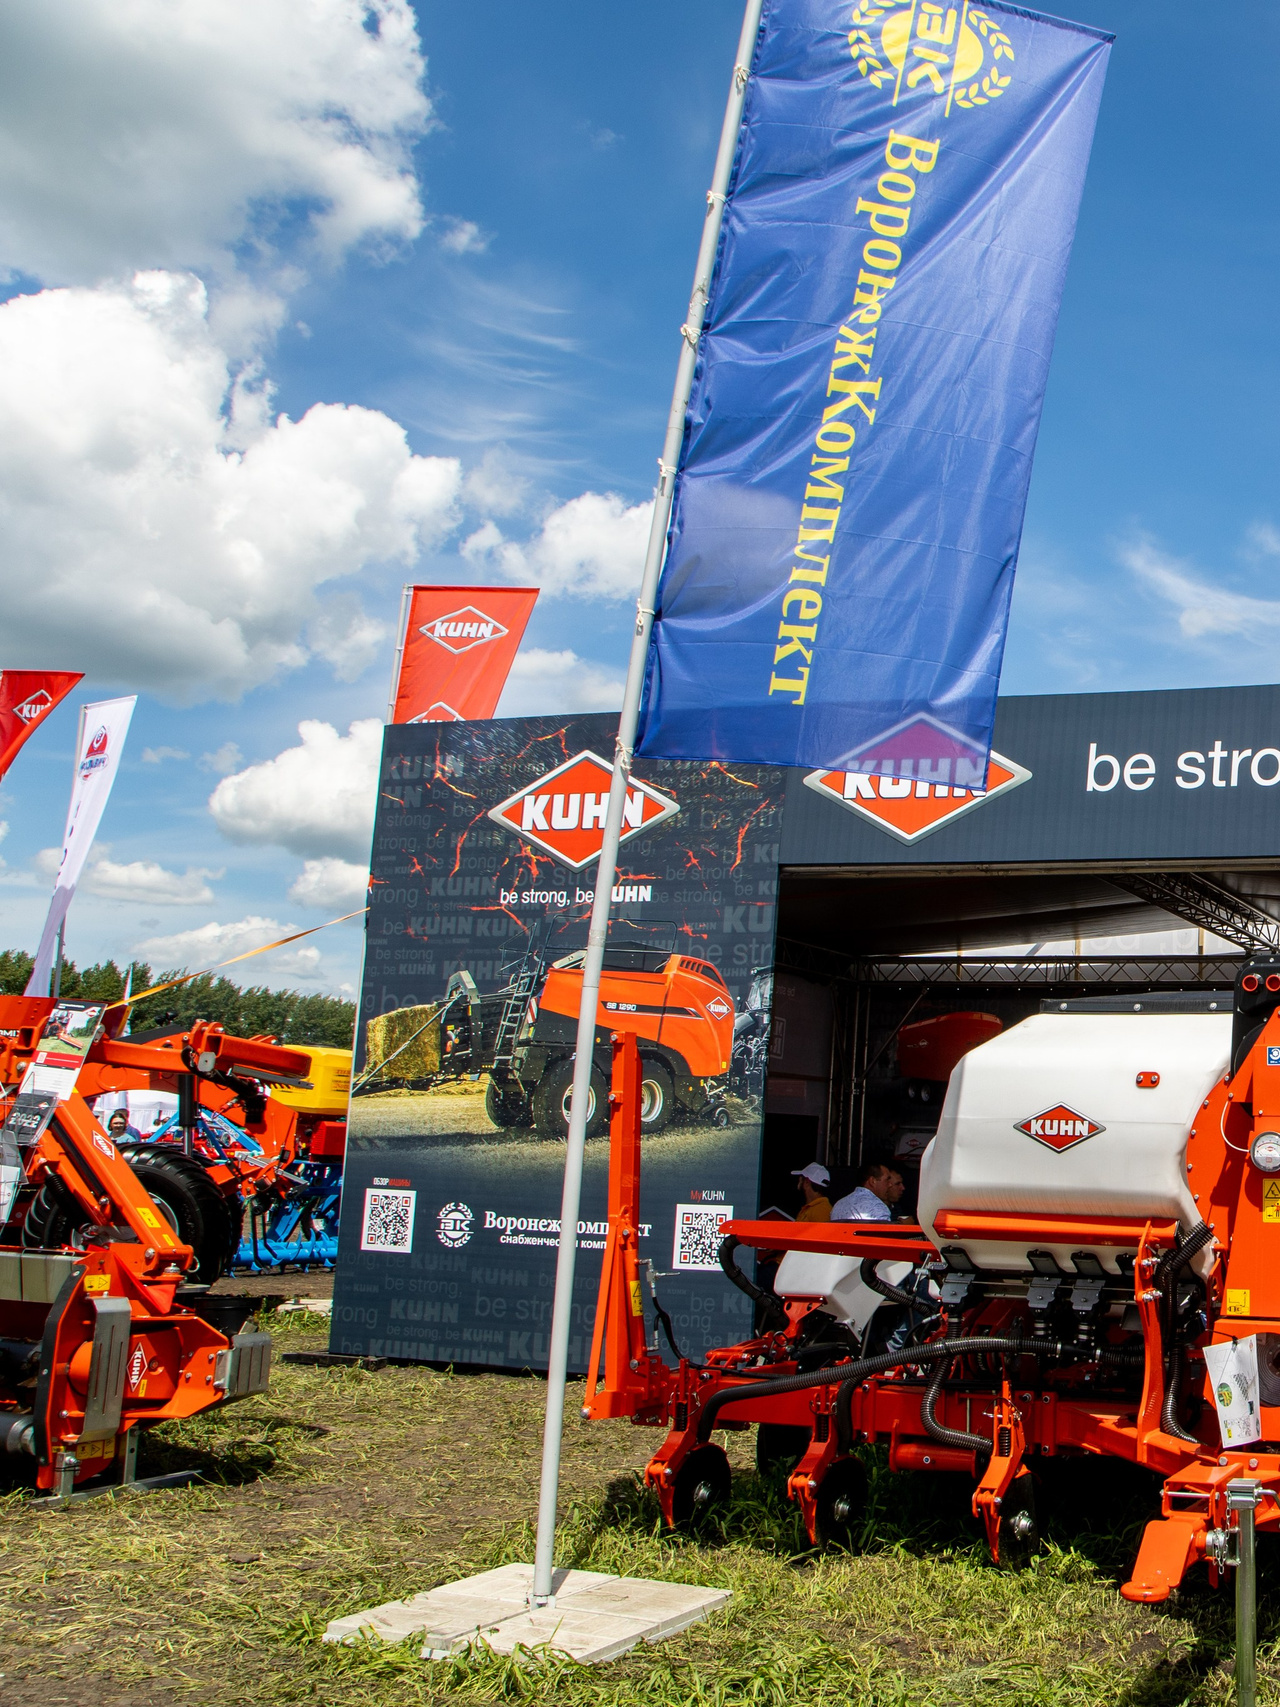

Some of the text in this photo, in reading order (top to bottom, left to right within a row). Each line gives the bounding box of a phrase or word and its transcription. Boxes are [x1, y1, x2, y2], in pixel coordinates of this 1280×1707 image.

[433, 620, 493, 639] KUHN
[382, 754, 465, 779] KUHN
[1086, 743, 1156, 792] be
[843, 757, 987, 800] KUHN
[386, 814, 431, 829] strong
[665, 864, 744, 884] be strong
[430, 876, 498, 897] KUHN
[500, 885, 652, 907] be strong, be UHN
[735, 881, 753, 896] be
[383, 916, 473, 935] be KUHN
[476, 918, 541, 937] KUHN
[376, 948, 434, 962] be strong
[383, 963, 397, 976] be
[398, 963, 436, 976] KUHN
[606, 1002, 637, 1011] SB 1290
[710, 1003, 728, 1013] KUHN
[1030, 1118, 1090, 1137] KUHN
[94, 1134, 113, 1159] KUHN
[690, 1190, 725, 1202] MyKUHN
[386, 1252, 405, 1268] be
[410, 1252, 468, 1273] KUHN
[385, 1274, 463, 1299] be strong,
[471, 1267, 528, 1288] KUHN
[390, 1299, 459, 1324] KUHN
[475, 1290, 507, 1317] be
[690, 1293, 715, 1313] be
[387, 1323, 504, 1343] be strong, be KUHN
[703, 1334, 722, 1347] be
[369, 1338, 435, 1361] KUHN
[131, 1352, 142, 1384] KUHN
